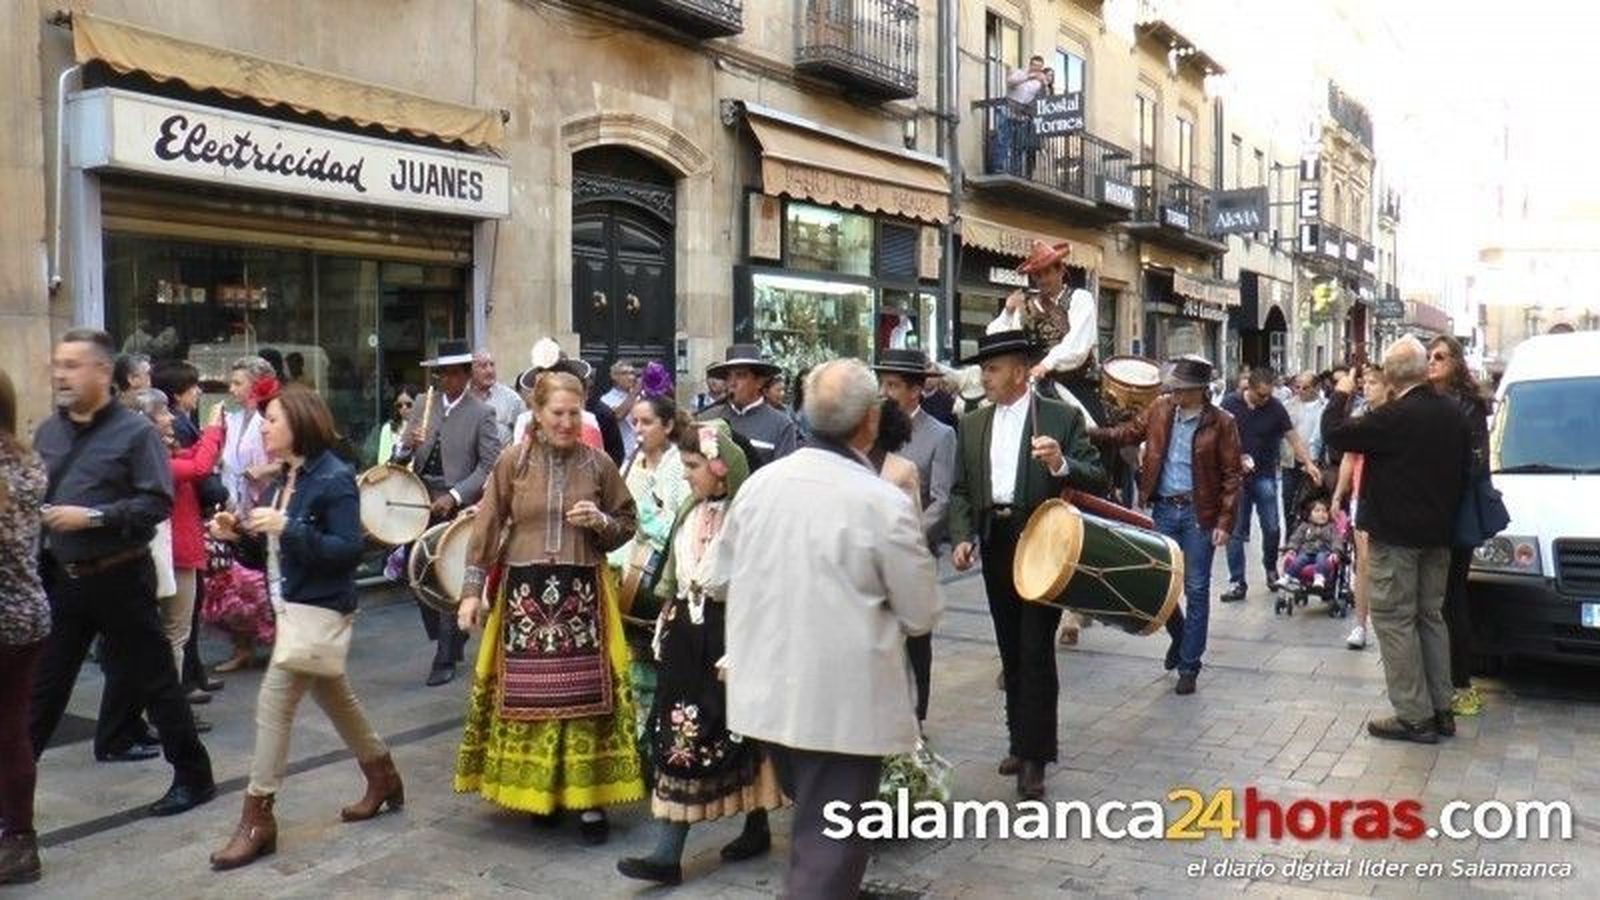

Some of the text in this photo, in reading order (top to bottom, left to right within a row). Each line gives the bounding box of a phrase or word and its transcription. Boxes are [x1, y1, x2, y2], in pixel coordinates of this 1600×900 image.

[1036, 93, 1079, 115] Hostal
[154, 114, 367, 193] Electricidad
[390, 159, 483, 202] JUANES
